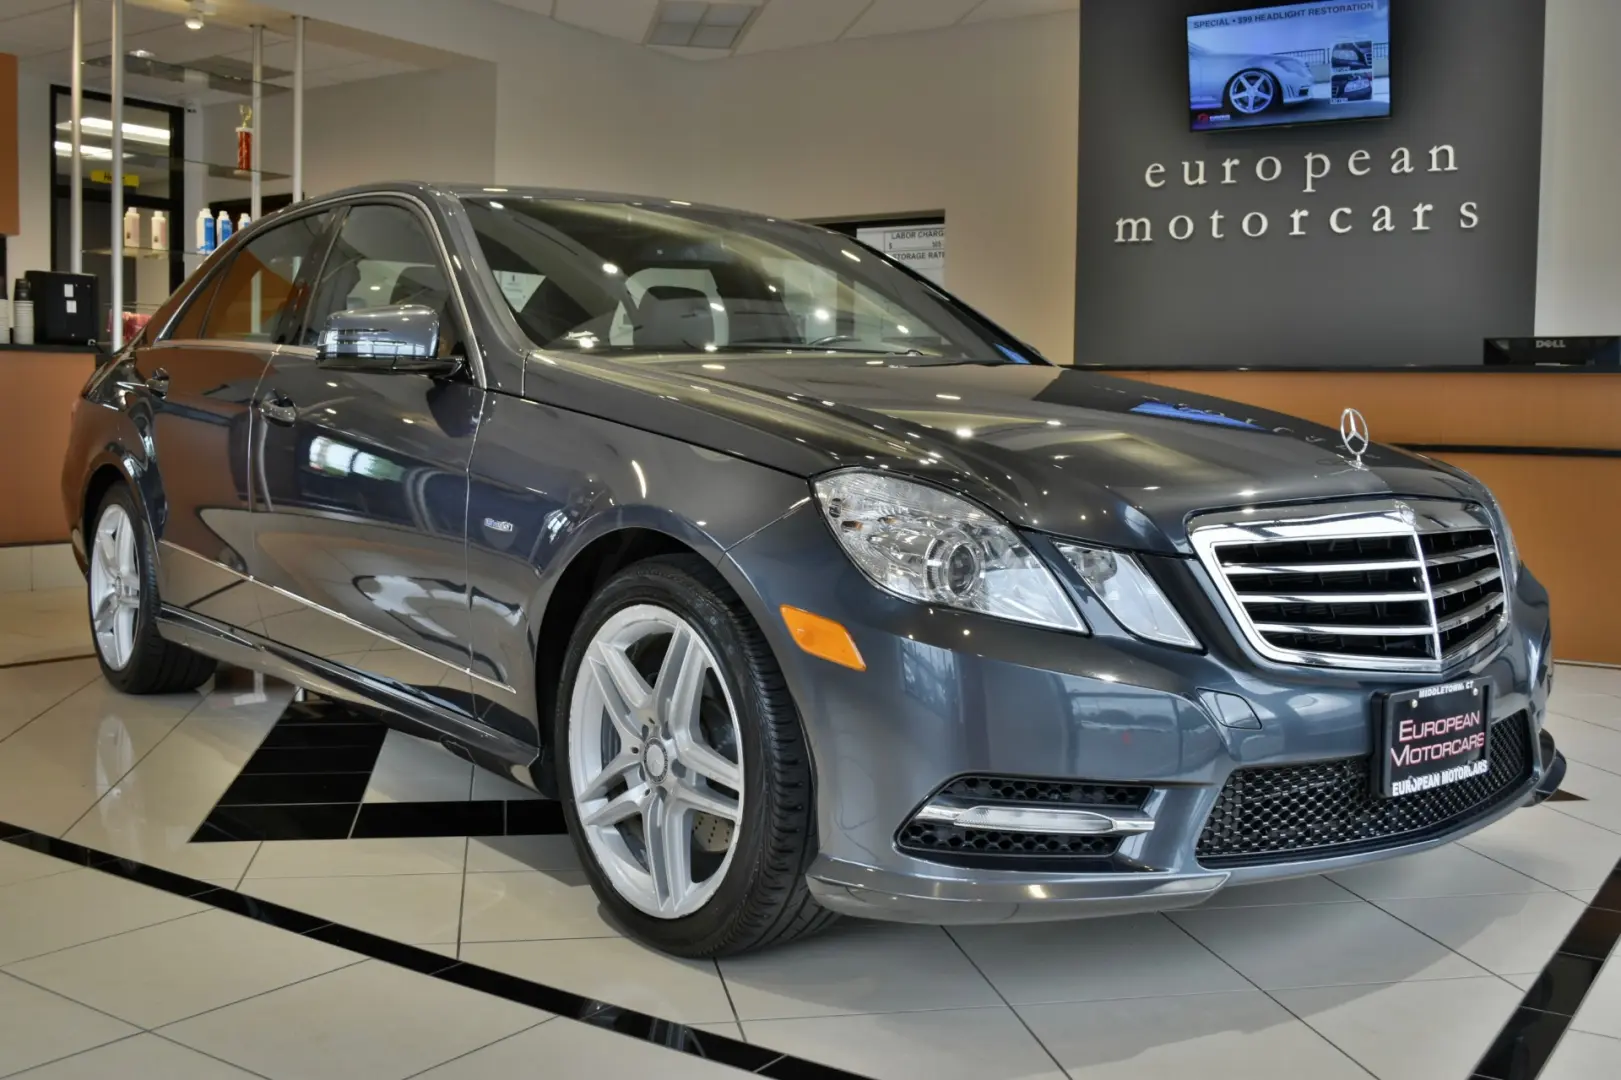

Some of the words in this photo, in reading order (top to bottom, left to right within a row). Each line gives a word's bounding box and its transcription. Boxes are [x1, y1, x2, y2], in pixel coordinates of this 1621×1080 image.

[1193, 18, 1230, 29] SPECIAL
[1238, 15, 1253, 25] $99
[1254, 9, 1306, 22] HEADLIGHT
[1308, 2, 1374, 16] RESTORATION
[1144, 143, 1459, 193] european
[891, 231, 917, 240] LABOR
[1113, 200, 1480, 243] motorcars
[1535, 339, 1566, 349] DELL
[1398, 710, 1481, 742] EUROPEAN
[1390, 732, 1485, 767] MOTORCARS
